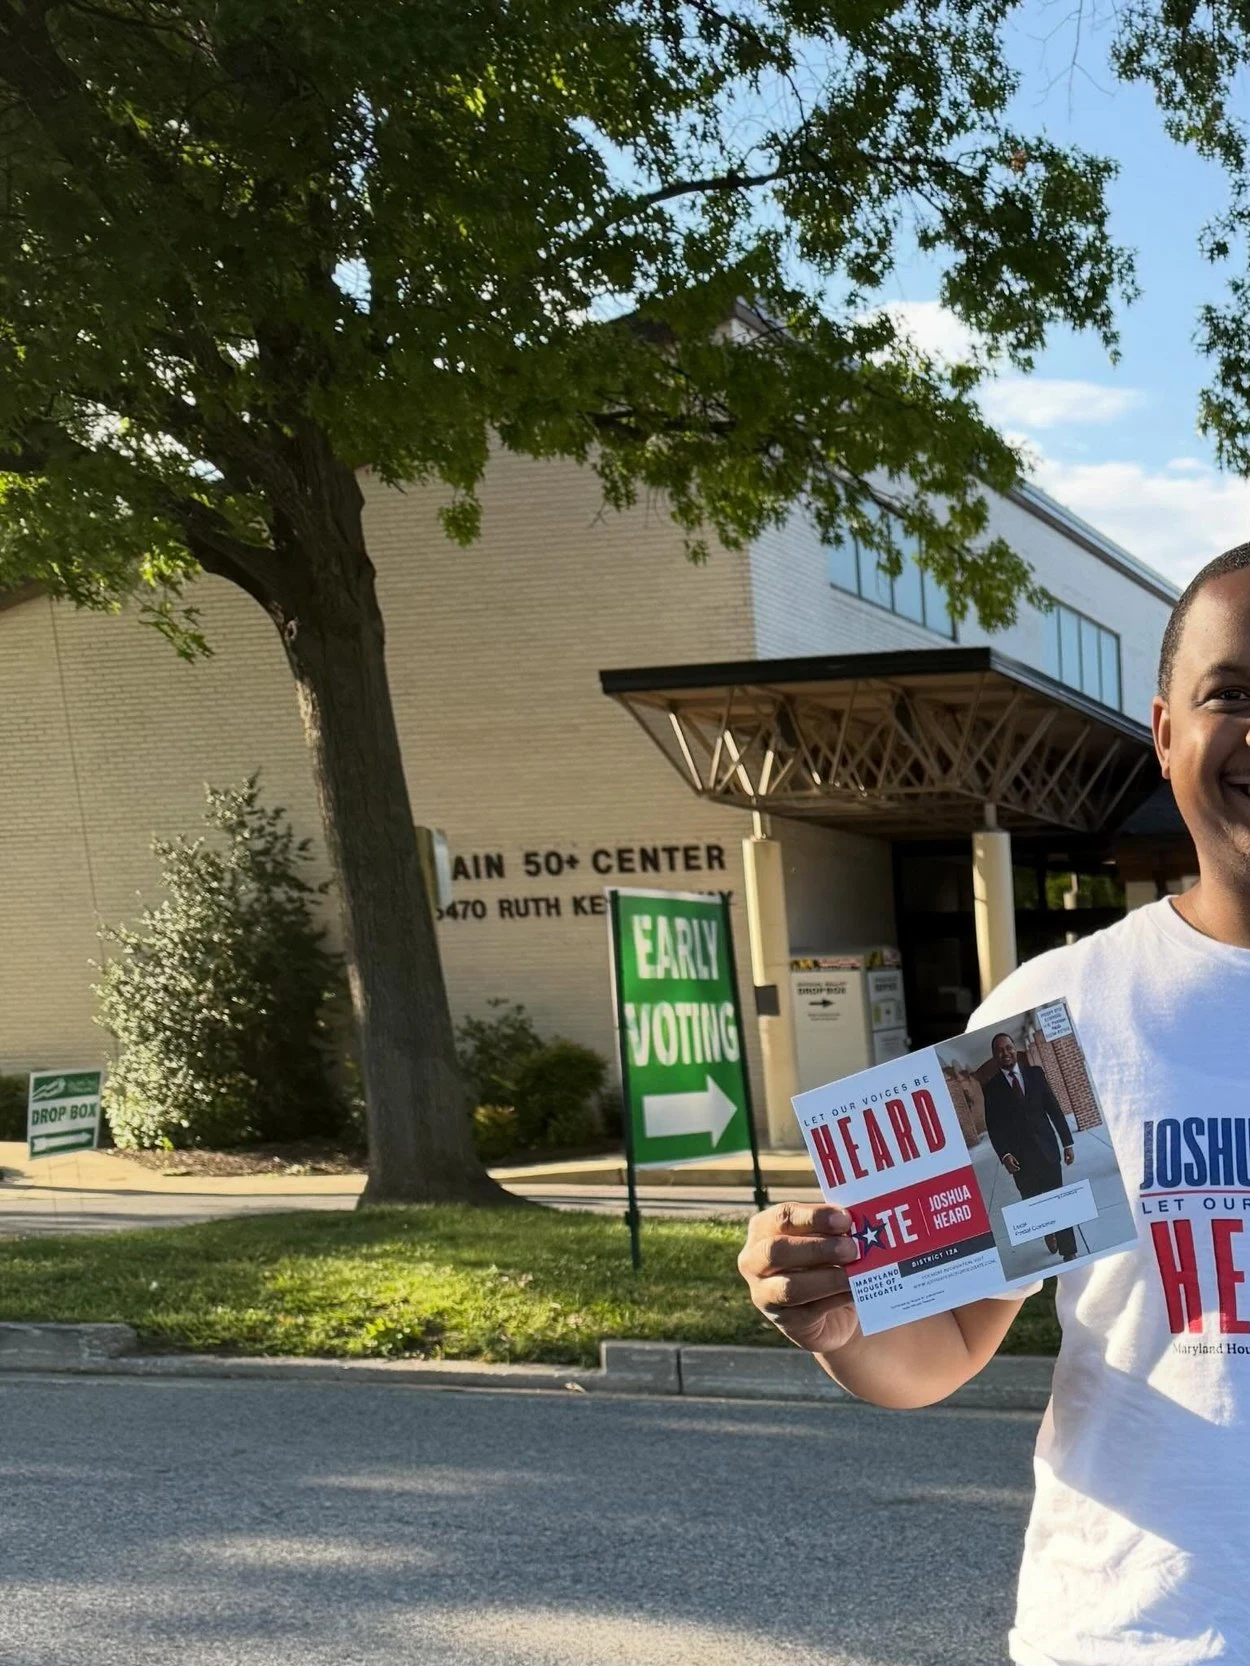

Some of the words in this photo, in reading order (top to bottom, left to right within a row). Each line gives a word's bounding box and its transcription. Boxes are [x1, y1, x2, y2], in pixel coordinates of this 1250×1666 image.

[450, 853, 505, 881] AIN
[524, 851, 579, 877] 50+
[592, 845, 726, 875] CENTER
[498, 896, 561, 920] RUTH
[632, 914, 720, 981] EARLY
[624, 1000, 740, 1067] VOTING
[803, 1113, 825, 1127] LET
[832, 1102, 857, 1117] OUR
[862, 1083, 909, 1105] VOICES
[914, 1075, 930, 1087] BE
[31, 1105, 67, 1126] DROP
[70, 1102, 97, 1120] BOX
[810, 1089, 946, 1189] HEARD
[928, 1184, 971, 1212] JOSHUA
[1141, 1198, 1185, 1215] LET
[933, 1204, 972, 1230] HEARD
[911, 1252, 944, 1268] DISTRICT
[855, 1268, 899, 1288] MARYLAND
[857, 1281, 884, 1295] HOUSE
[859, 1283, 904, 1303] DELEGATES
